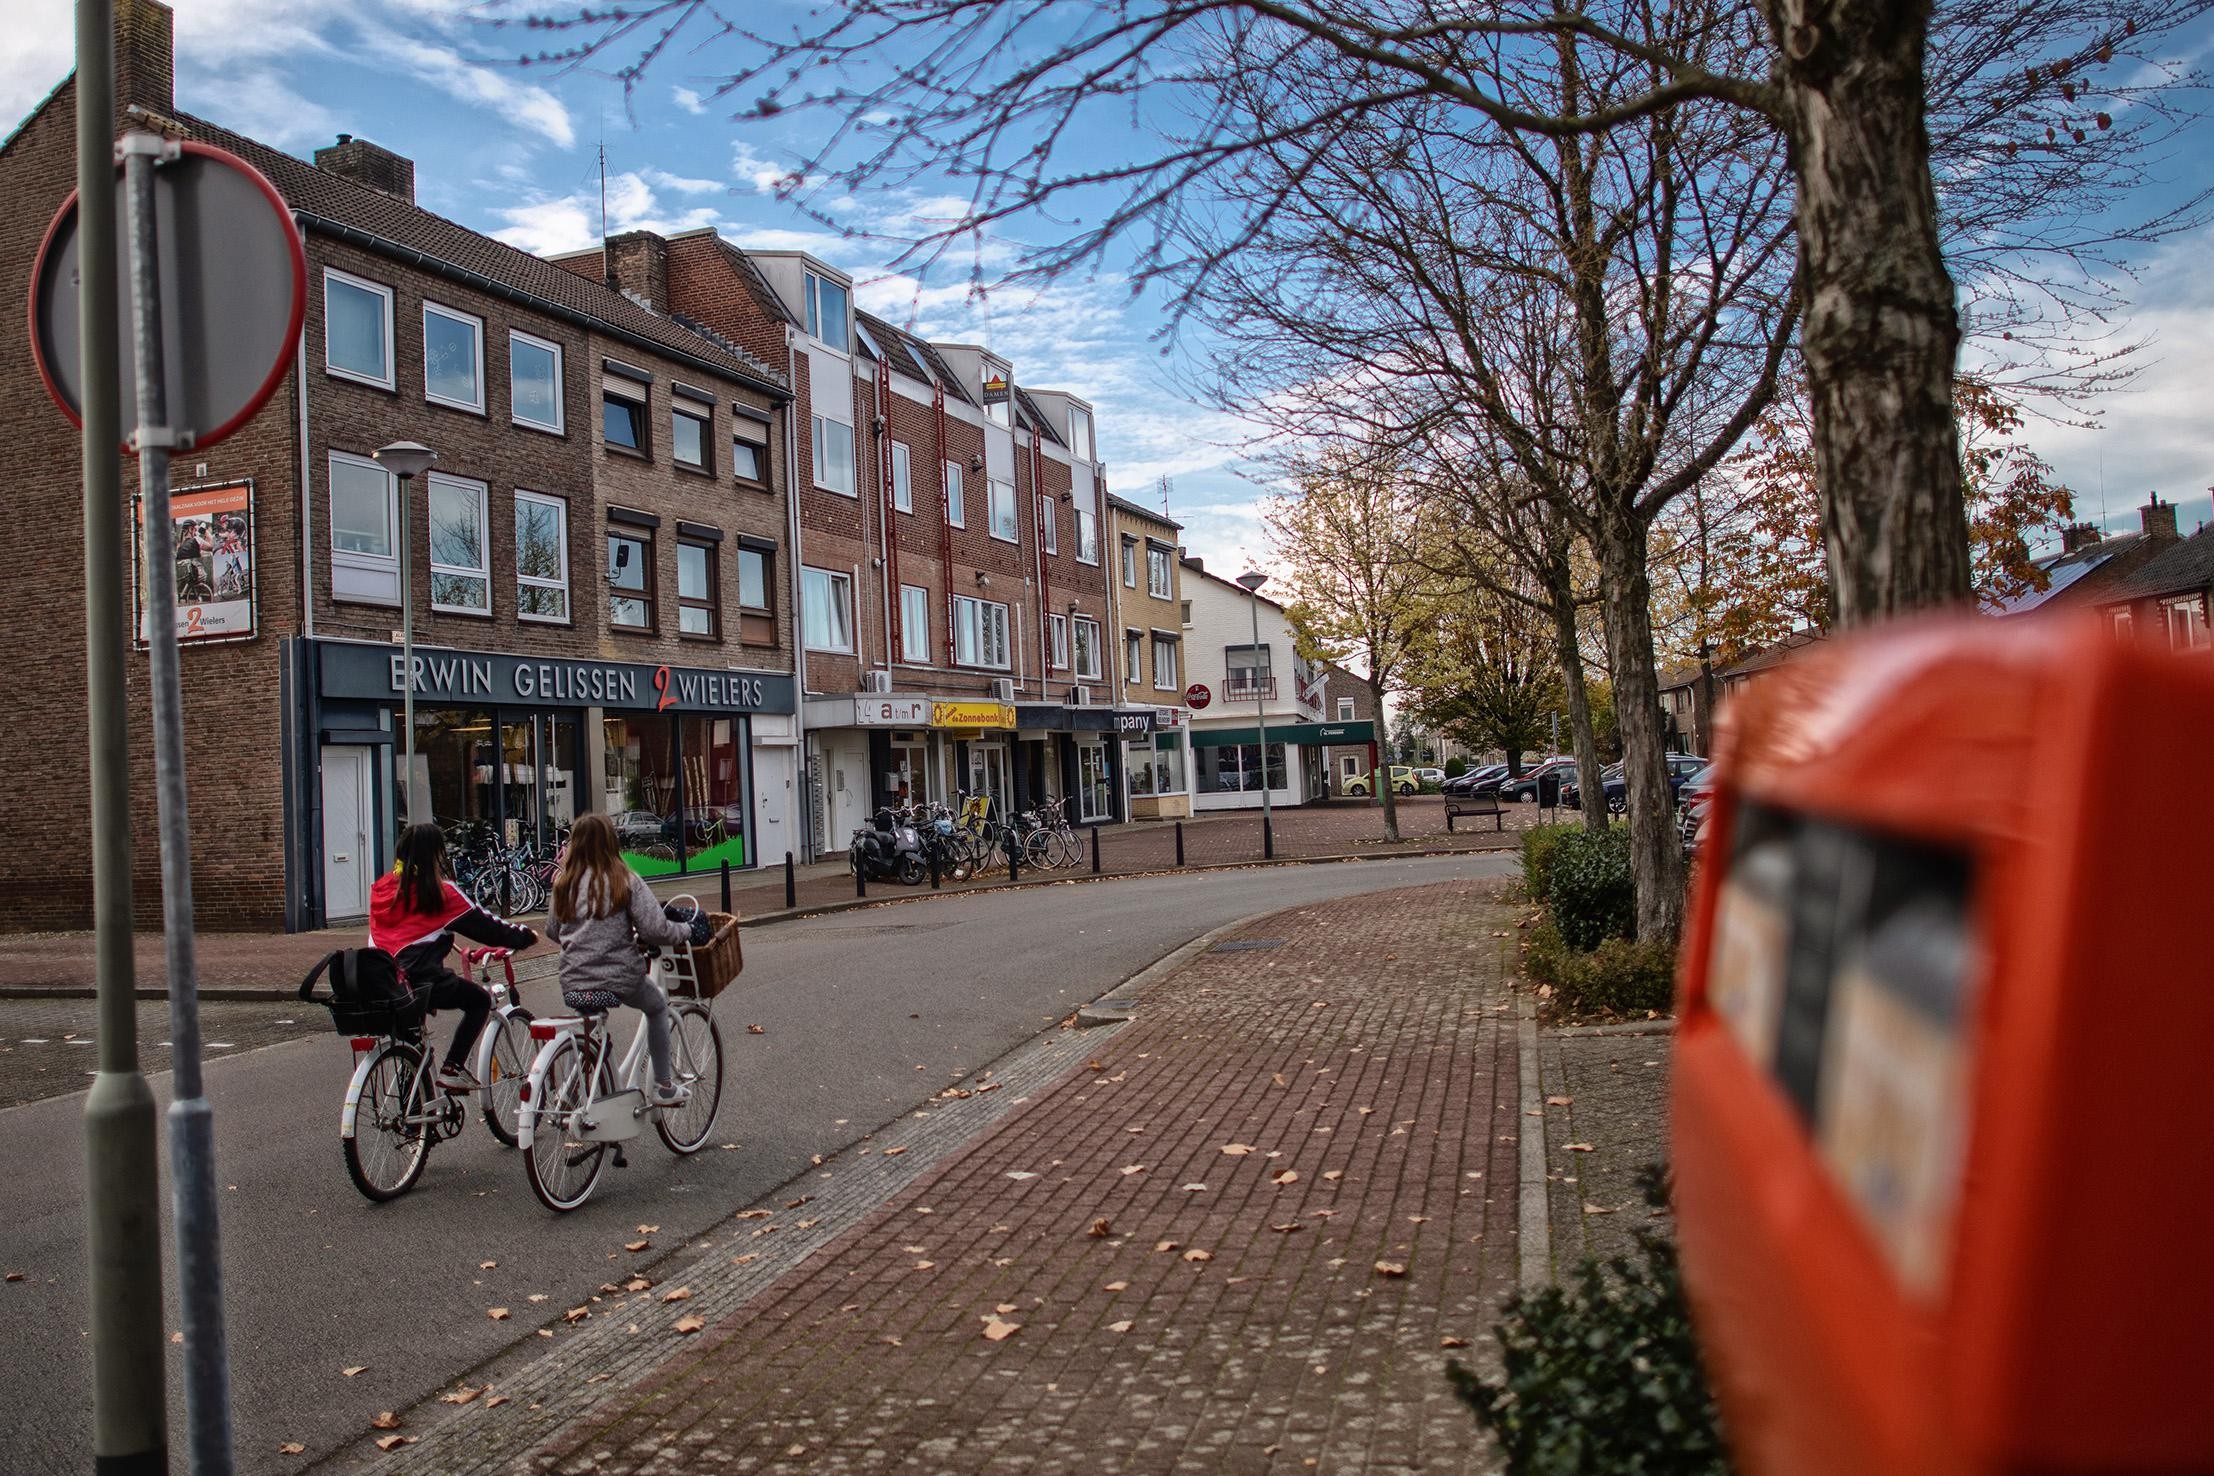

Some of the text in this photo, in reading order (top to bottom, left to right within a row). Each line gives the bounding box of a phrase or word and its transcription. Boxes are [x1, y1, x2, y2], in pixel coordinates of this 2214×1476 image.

[187, 607, 205, 634] 2
[200, 616, 226, 625] Wielers
[390, 655, 763, 712] ERWIN GELISSEN 2 WIELERS
